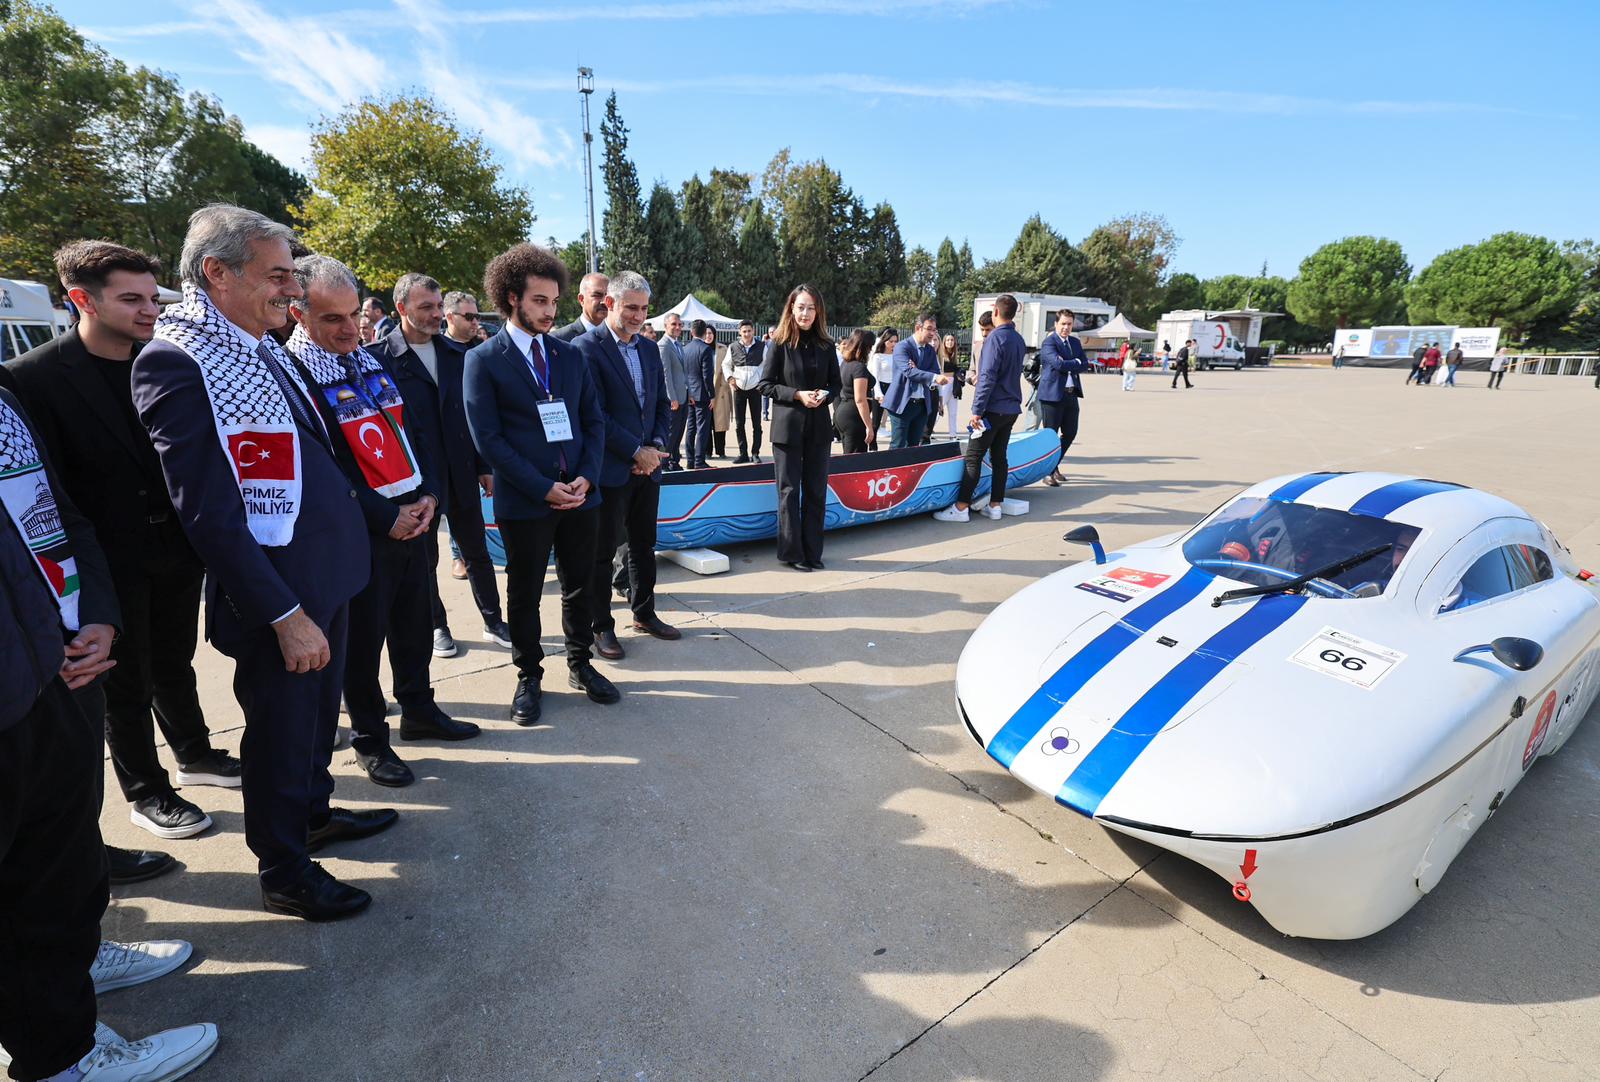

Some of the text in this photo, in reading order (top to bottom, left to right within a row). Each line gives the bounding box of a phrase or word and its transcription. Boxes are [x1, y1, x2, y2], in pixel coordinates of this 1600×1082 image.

[242, 487, 286, 499] PİMİZ
[245, 500, 294, 515] İNLİYİZ
[1319, 649, 1367, 671] 66
